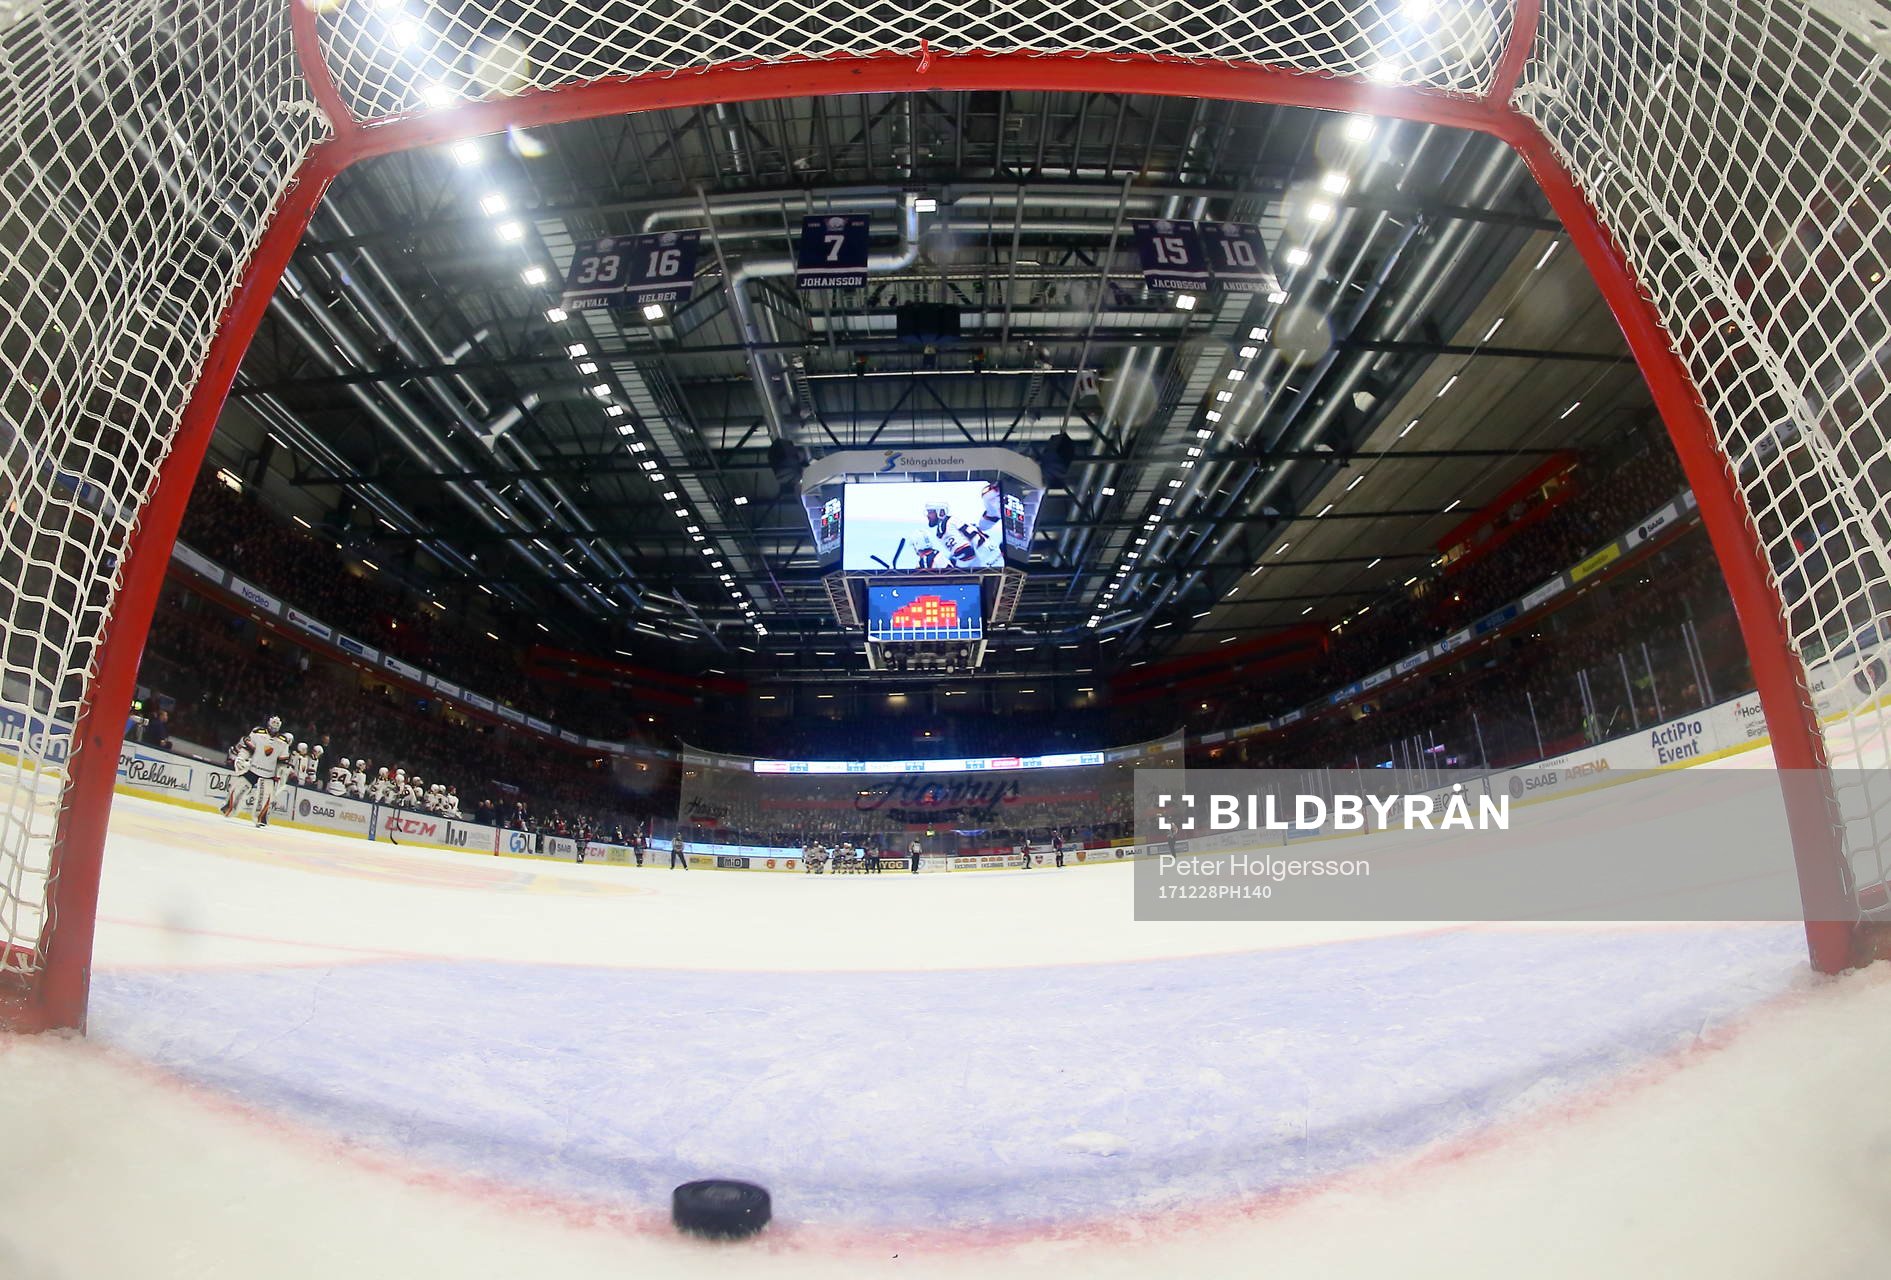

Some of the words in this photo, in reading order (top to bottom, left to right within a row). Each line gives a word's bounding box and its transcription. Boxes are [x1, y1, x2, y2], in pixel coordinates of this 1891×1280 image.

[824, 235, 845, 261] 7
[1153, 237, 1188, 265] 15
[1220, 240, 1256, 267] 10
[577, 255, 620, 283] 33
[646, 249, 681, 278] 16
[801, 277, 863, 287] JOHANSSON
[1152, 279, 1207, 291] JACOBSSON
[638, 291, 678, 303] HELBER
[900, 455, 965, 467] Stångåstaden
[241, 585, 270, 609] Nordea
[0, 714, 68, 759] inen
[1651, 720, 1703, 748] ActiPro
[1658, 739, 1700, 764] Event
[128, 760, 177, 789] Reklam
[331, 771, 347, 785] 24
[1525, 772, 1558, 790] SAAB
[1564, 758, 1610, 782] ARENA
[312, 805, 336, 818] SAAB
[339, 811, 367, 823] ARENA
[384, 815, 438, 837] CCM
